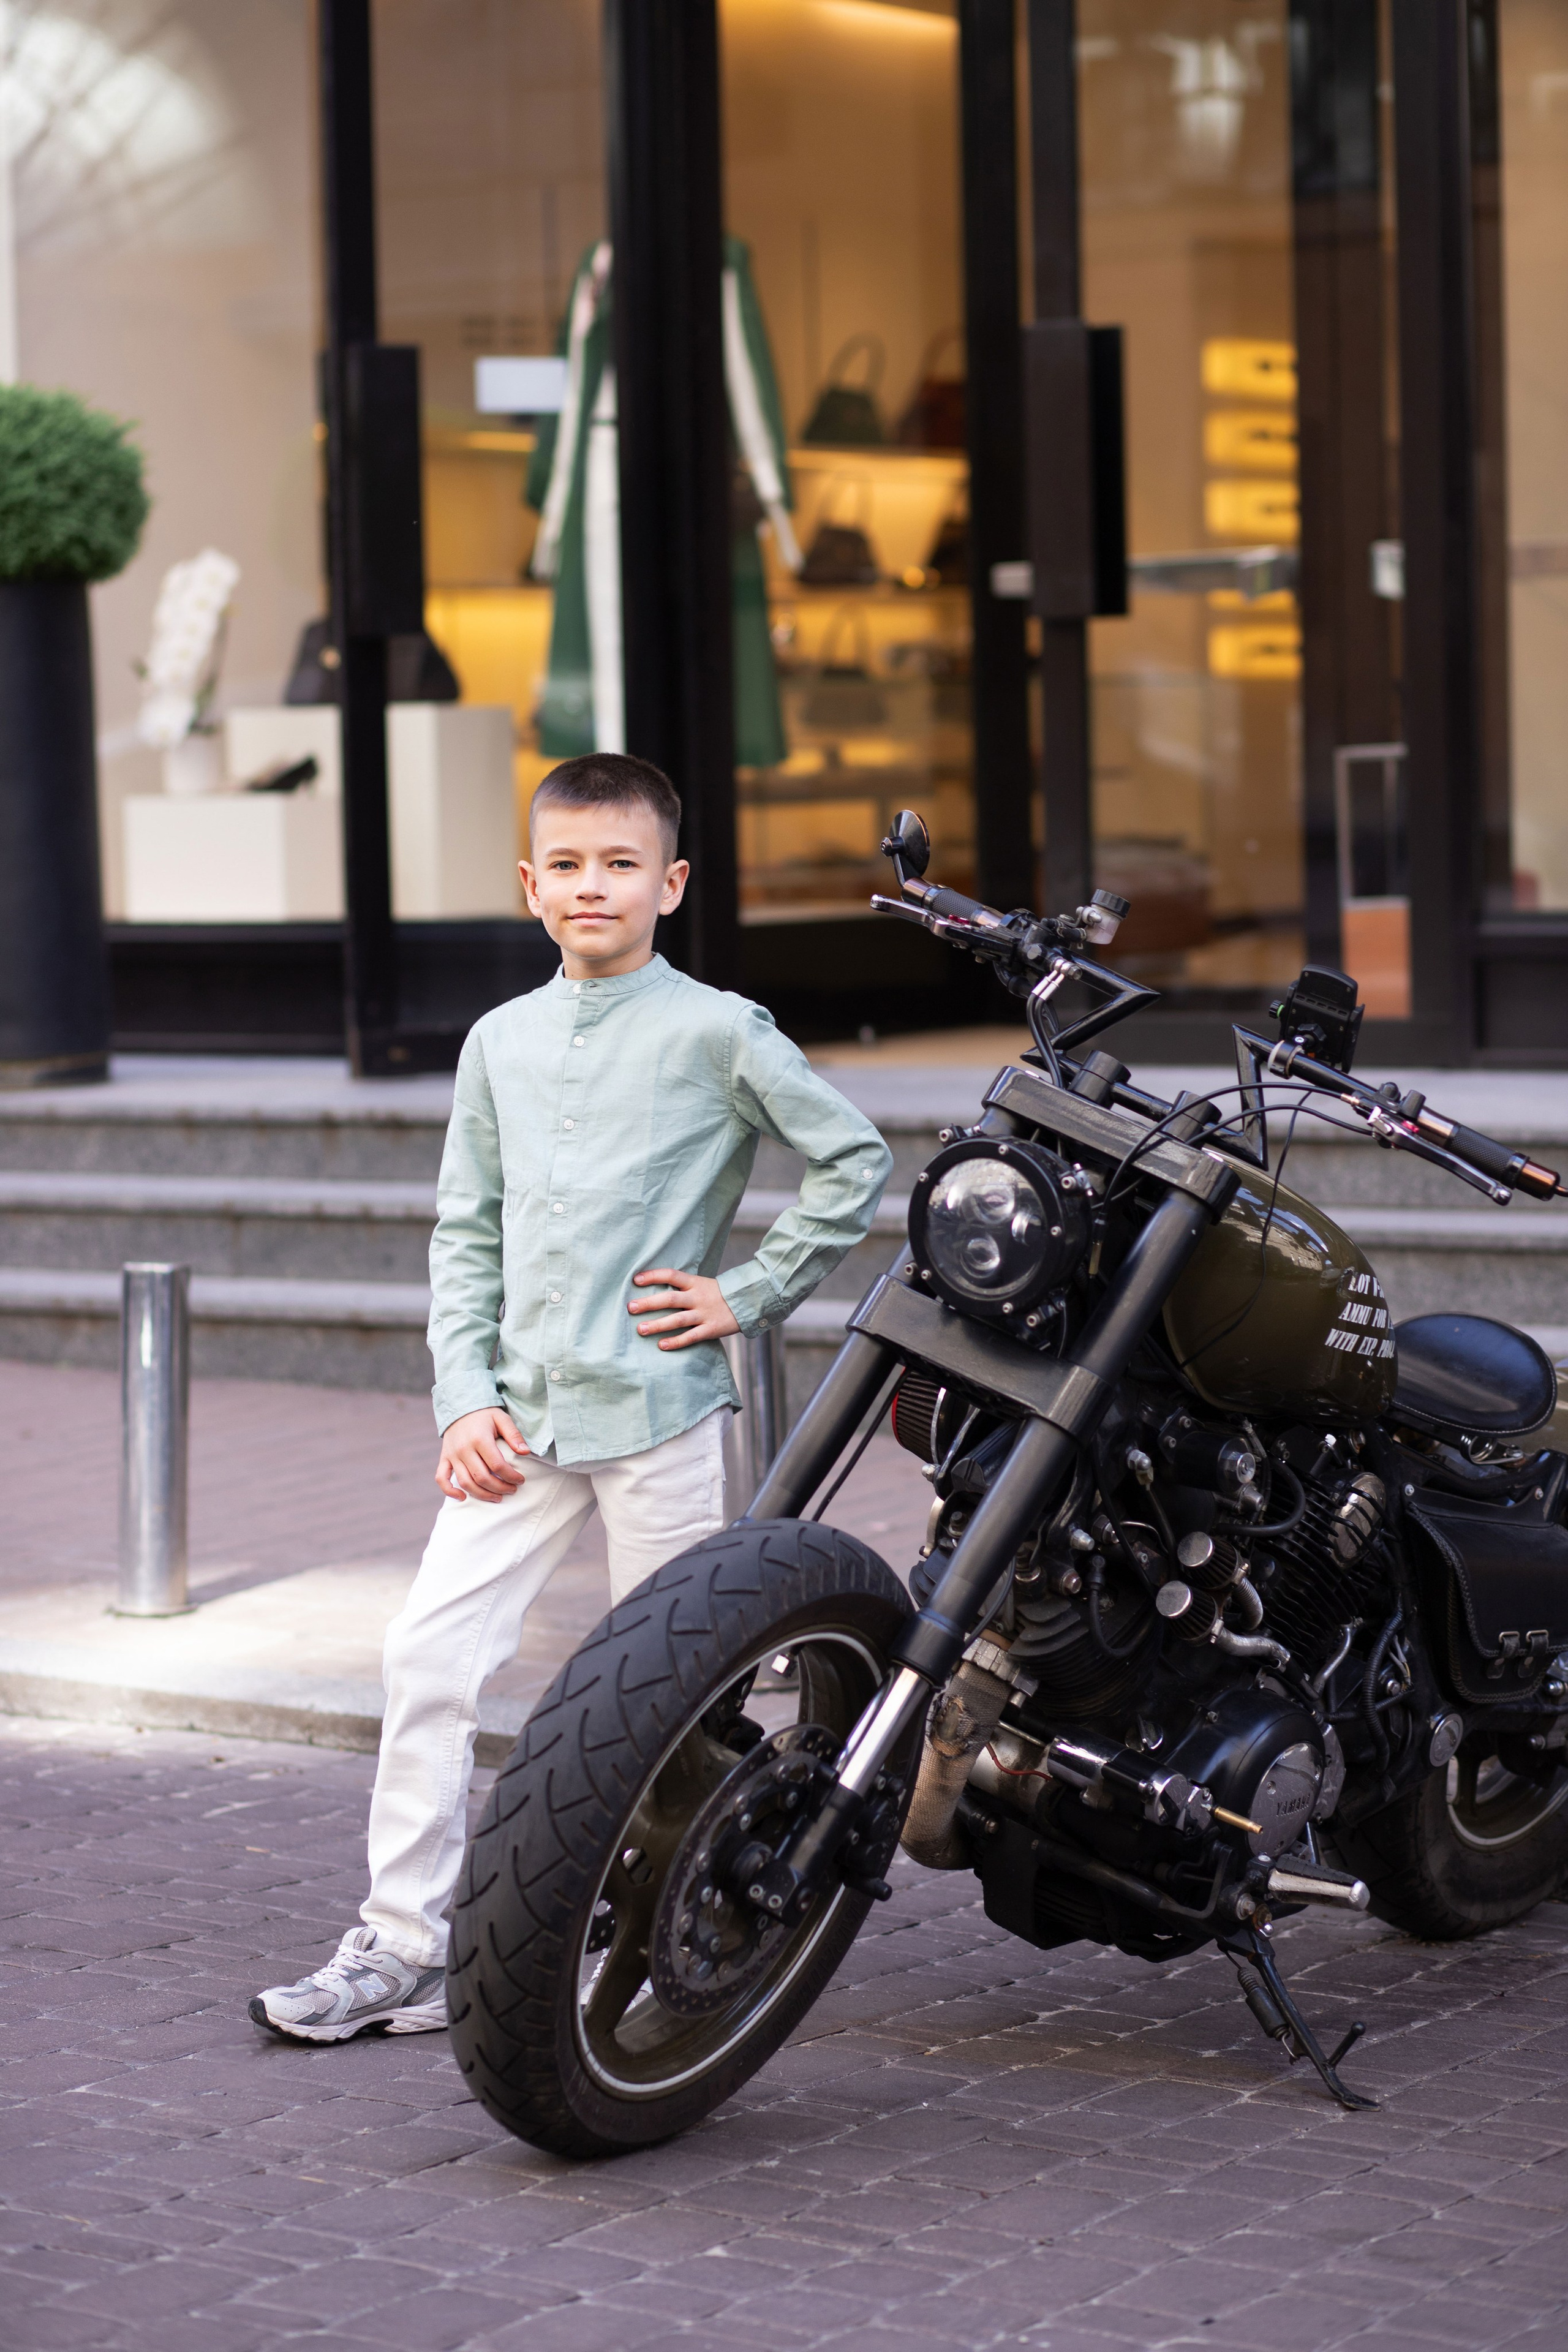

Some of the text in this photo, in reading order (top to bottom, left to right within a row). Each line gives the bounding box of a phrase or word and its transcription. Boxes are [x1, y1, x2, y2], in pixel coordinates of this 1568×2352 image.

[1348, 1273, 1371, 1294] LOT
[1338, 1302, 1373, 1325] AMMU
[1371, 1308, 1387, 1329] FOR
[1324, 1329, 1360, 1352] WITH
[1357, 1336, 1378, 1356] EXP.
[355, 1973, 389, 1999] N
